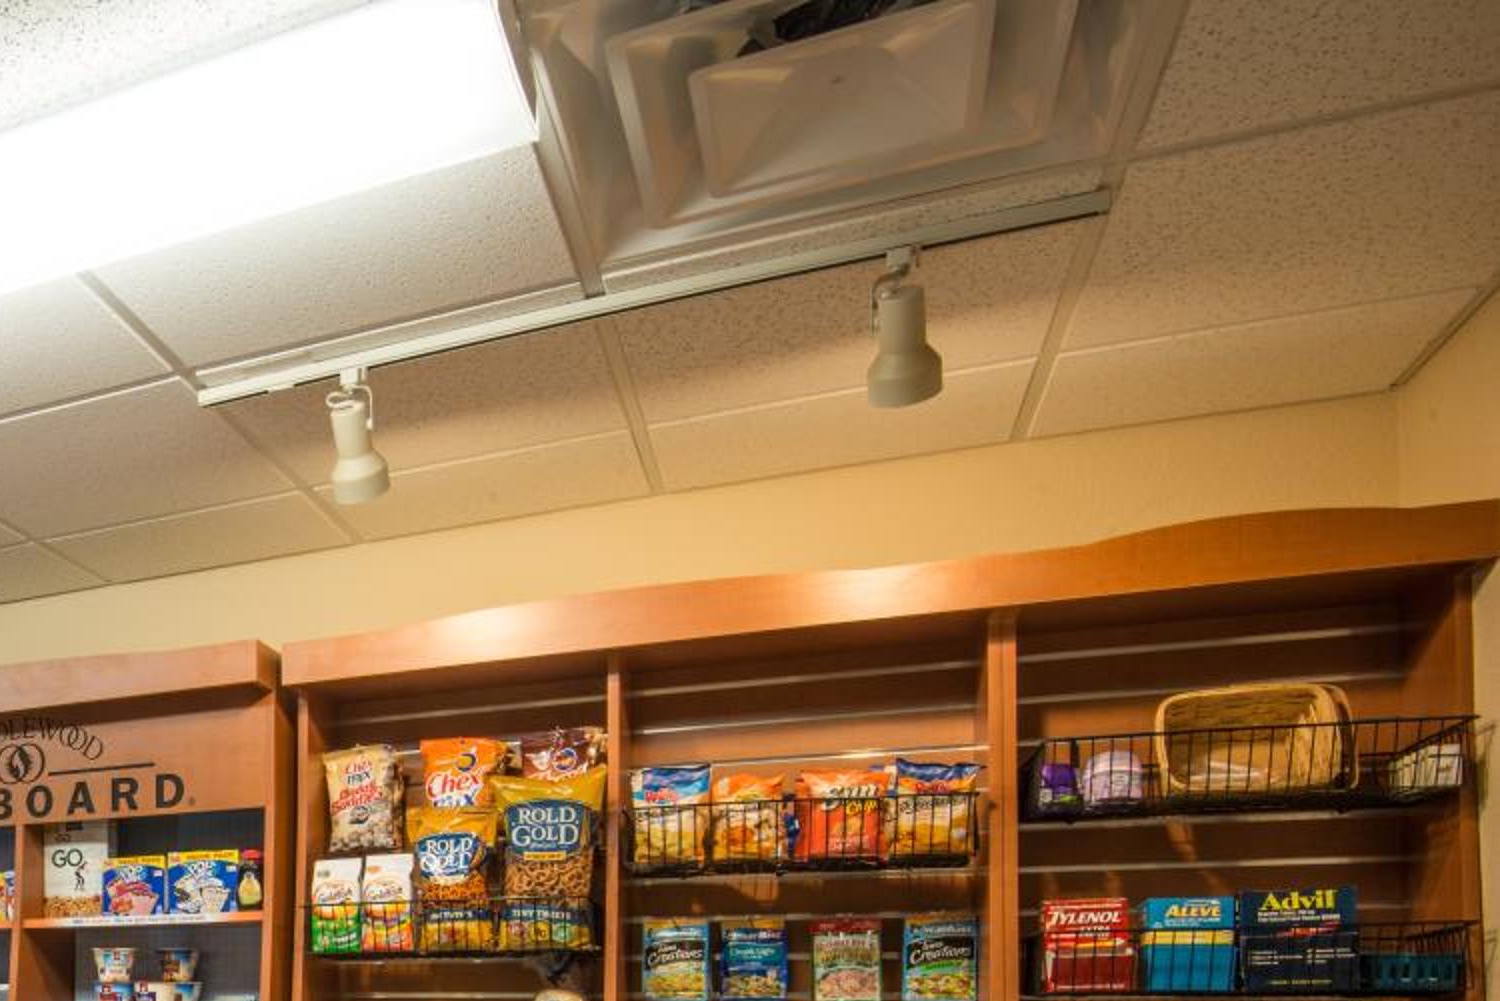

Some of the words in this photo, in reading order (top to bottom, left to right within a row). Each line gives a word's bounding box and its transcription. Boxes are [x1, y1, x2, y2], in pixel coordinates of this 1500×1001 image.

[427, 773, 481, 799] Chex
[518, 807, 577, 824] ROLD
[511, 824, 579, 847] GOLD
[426, 838, 472, 854] ROLD
[51, 848, 83, 868] GO
[1259, 889, 1338, 910] Advil
[1050, 911, 1121, 925] TYLENOL
[1165, 904, 1221, 918] ALEVE
